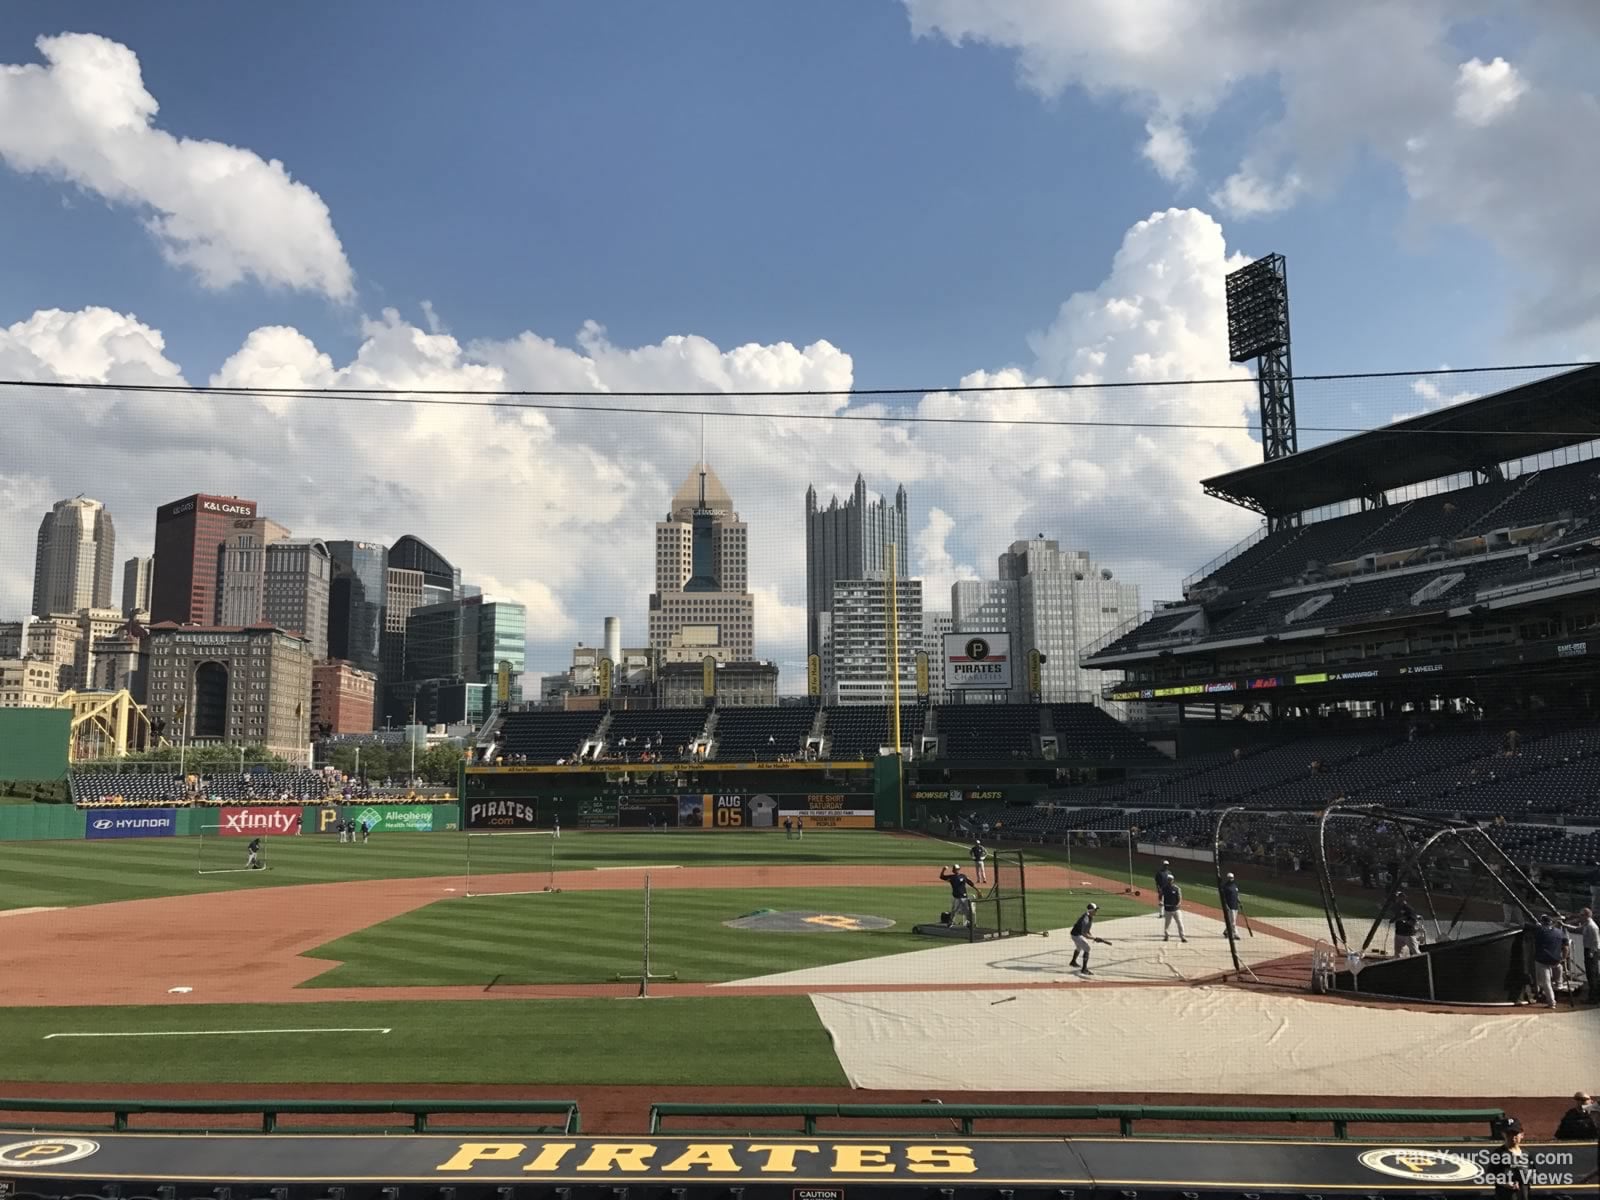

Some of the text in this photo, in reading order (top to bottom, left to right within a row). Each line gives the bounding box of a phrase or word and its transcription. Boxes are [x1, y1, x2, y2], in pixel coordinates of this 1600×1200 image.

[203, 501, 251, 515] K&L GATES
[973, 643, 983, 657] P
[954, 664, 1002, 674] PIRATES
[1414, 664, 1443, 673] WHEELER
[718, 795, 741, 807] AUG
[809, 802, 843, 810] SATURDAY
[385, 811, 432, 821] Allegheny
[471, 801, 534, 822] PIRATES
[717, 807, 742, 826] 05
[116, 818, 170, 829] HYUNDAI
[226, 810, 296, 832] xfinity
[320, 808, 337, 832] P
[435, 1143, 979, 1174] PIRATES
